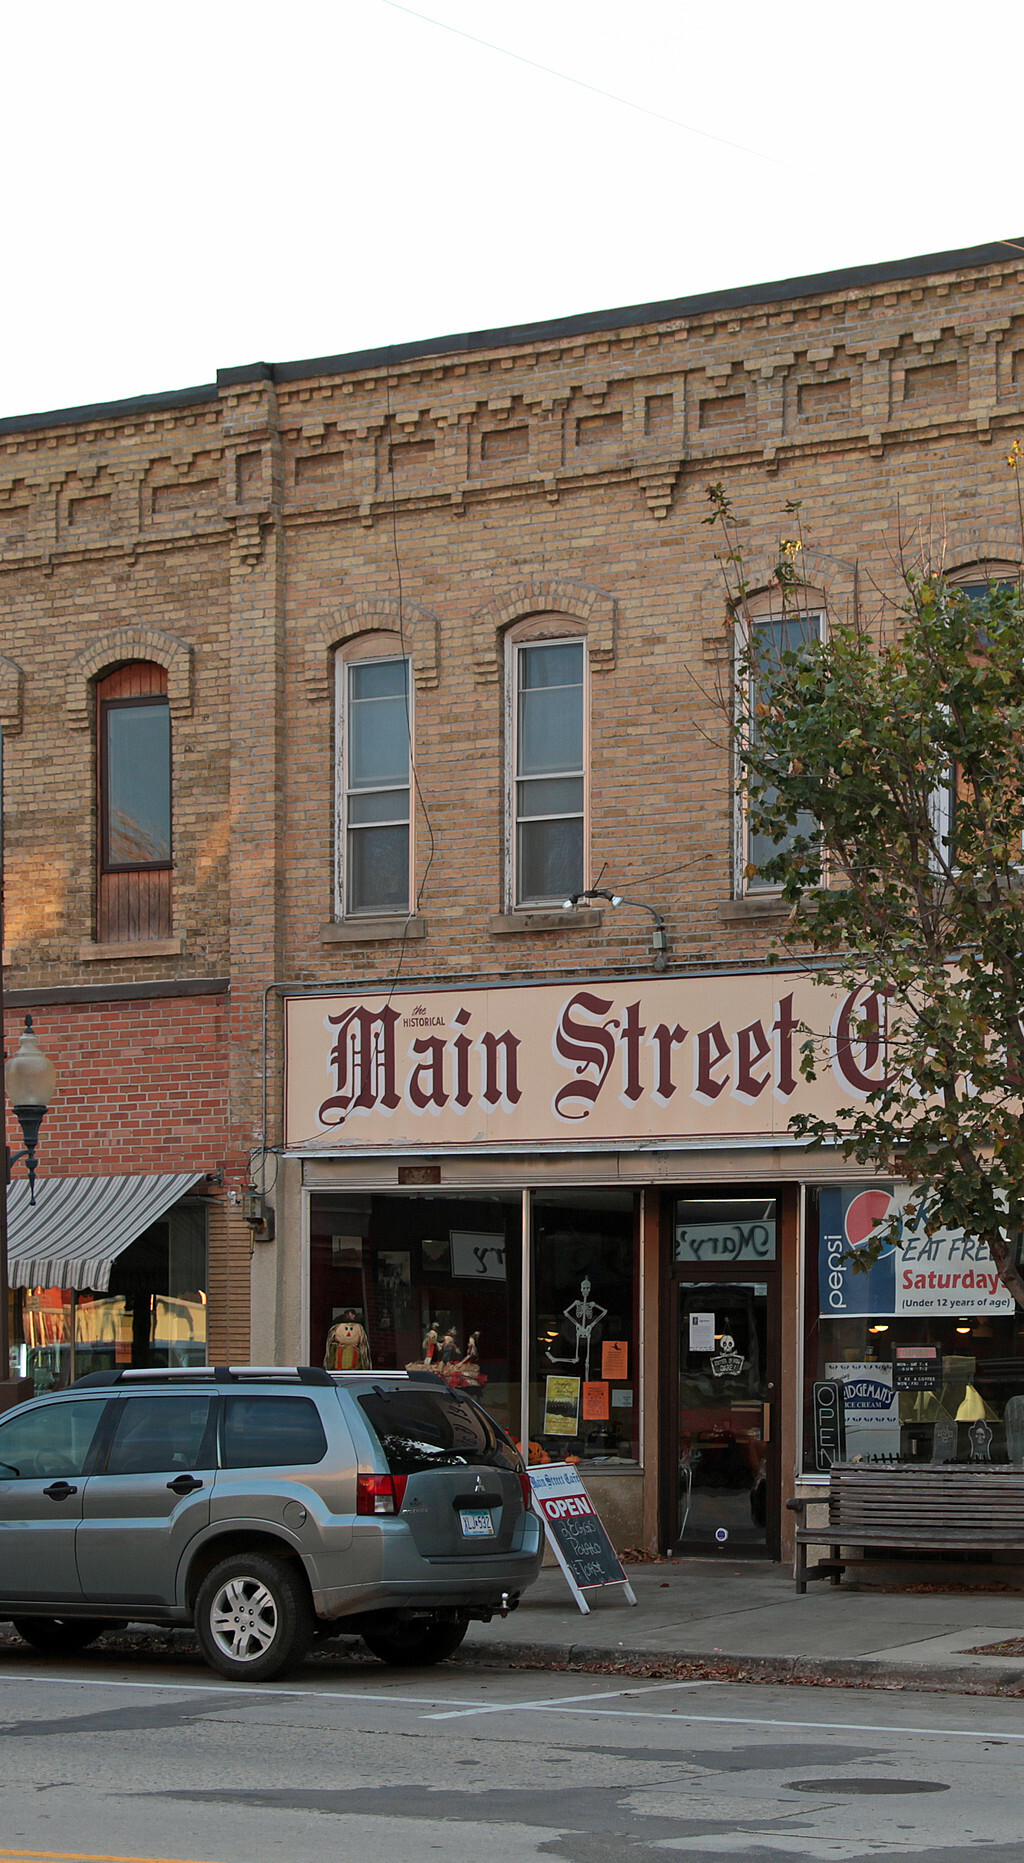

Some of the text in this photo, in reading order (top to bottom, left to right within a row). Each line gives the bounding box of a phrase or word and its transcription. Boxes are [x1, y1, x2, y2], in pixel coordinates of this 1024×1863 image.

[402, 1016, 446, 1028] HISTORICAL
[411, 1004, 427, 1016] the
[317, 1003, 523, 1126] Main
[554, 991, 801, 1120] Street
[901, 1237, 995, 1262] EAT FRE
[823, 1235, 847, 1308] pepsi
[902, 1298, 1011, 1309] (Under 12 years of age)
[817, 1386, 836, 1466] OPEN
[545, 1496, 592, 1519] OPEN
